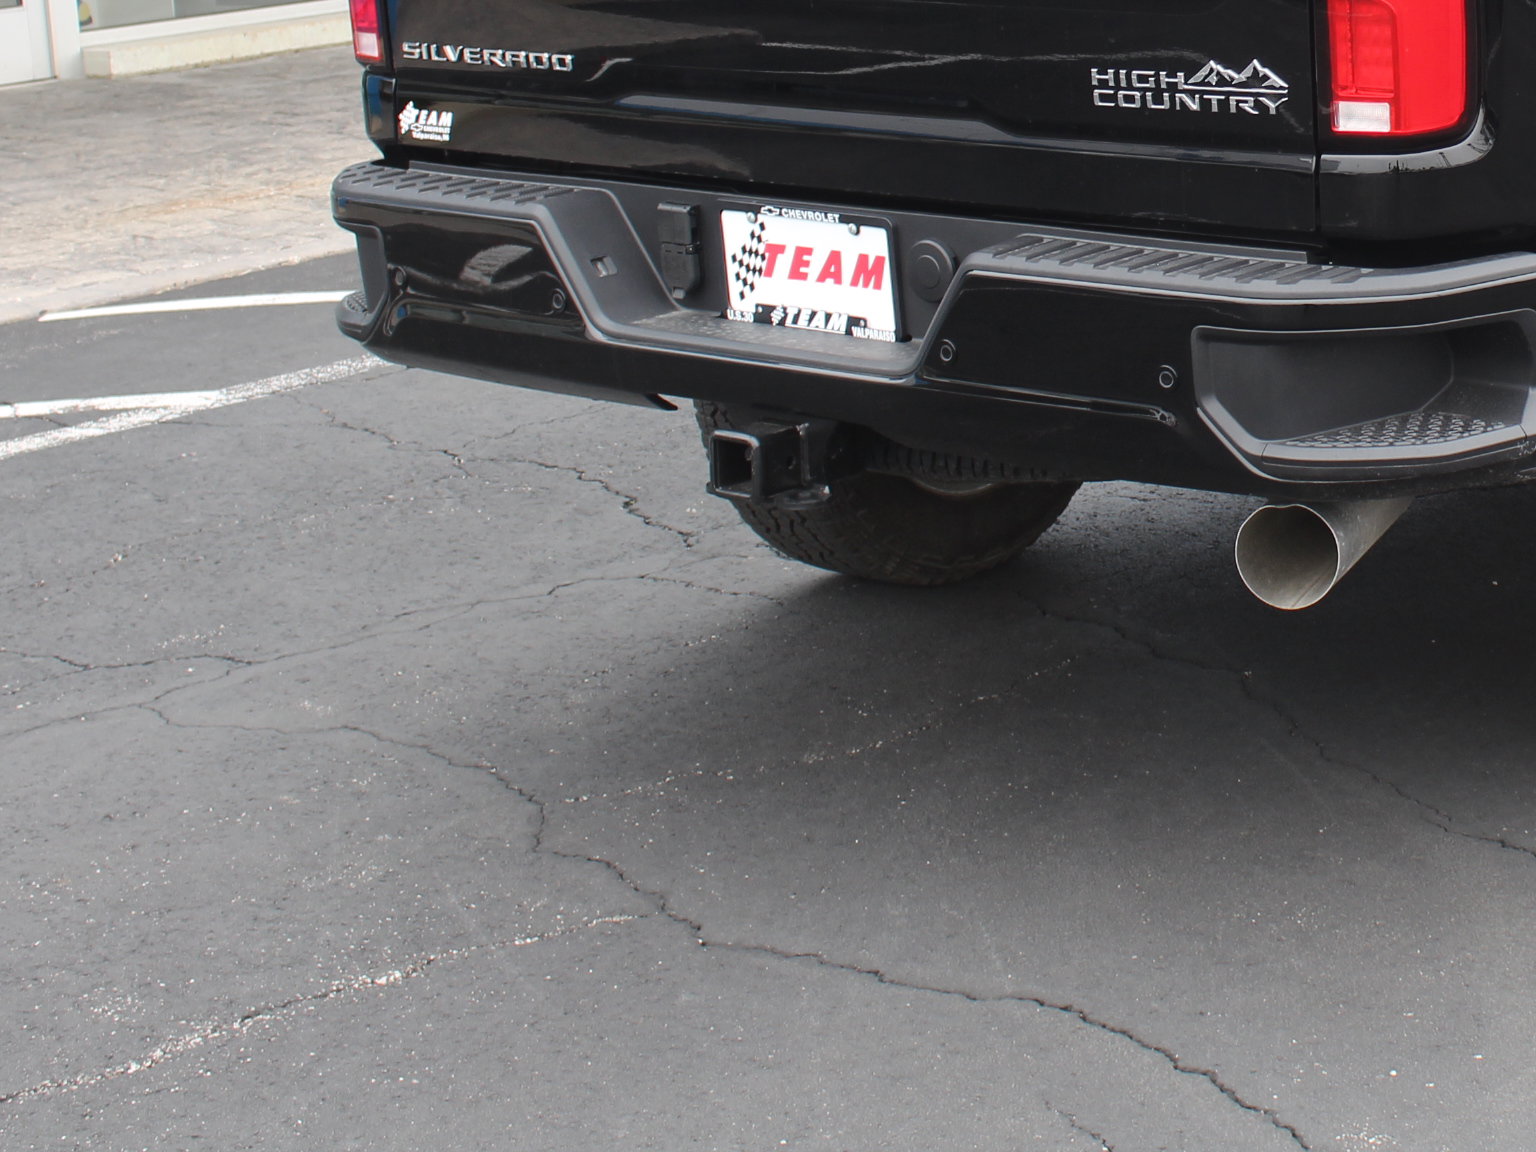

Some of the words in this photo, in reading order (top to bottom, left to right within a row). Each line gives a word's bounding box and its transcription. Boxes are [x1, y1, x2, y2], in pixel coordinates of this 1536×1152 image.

[402, 41, 574, 71] SILVERADO
[1090, 68, 1185, 90] HIGH
[1092, 89, 1289, 115] COUNTRY
[410, 107, 454, 127] TEAM
[781, 208, 841, 224] CHEVROLET
[763, 242, 887, 291] TEAM
[784, 306, 850, 333] TEAM
[852, 327, 896, 343] VALPARAISO
